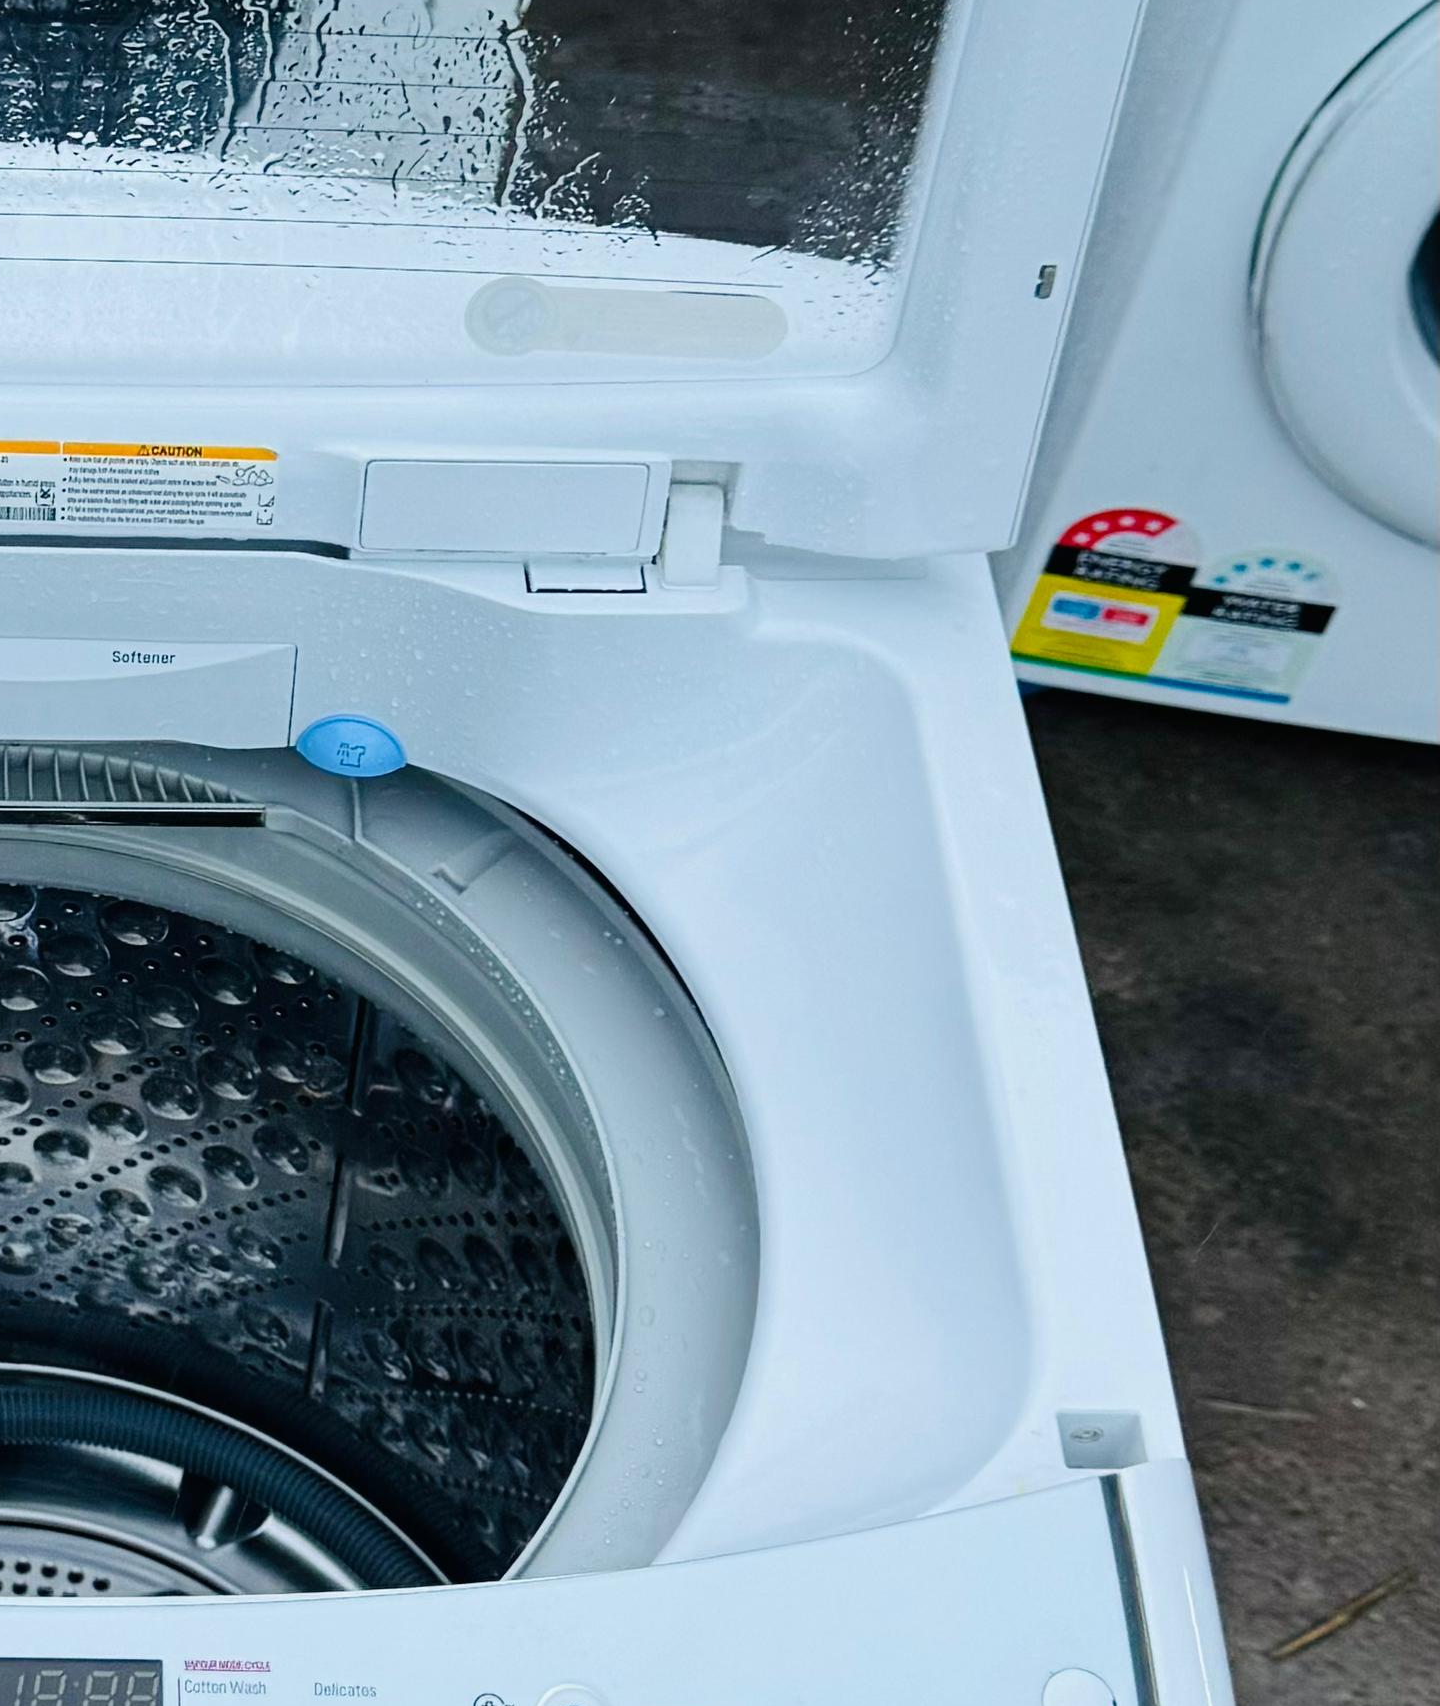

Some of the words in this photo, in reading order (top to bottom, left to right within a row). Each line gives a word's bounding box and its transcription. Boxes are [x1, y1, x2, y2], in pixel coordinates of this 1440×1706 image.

[151, 446, 202, 457] CAUTION
[112, 649, 175, 666] Softener
[185, 1679, 227, 1695] Cotton
[231, 1681, 267, 1695] Wash
[314, 1682, 377, 1698] Delicates
